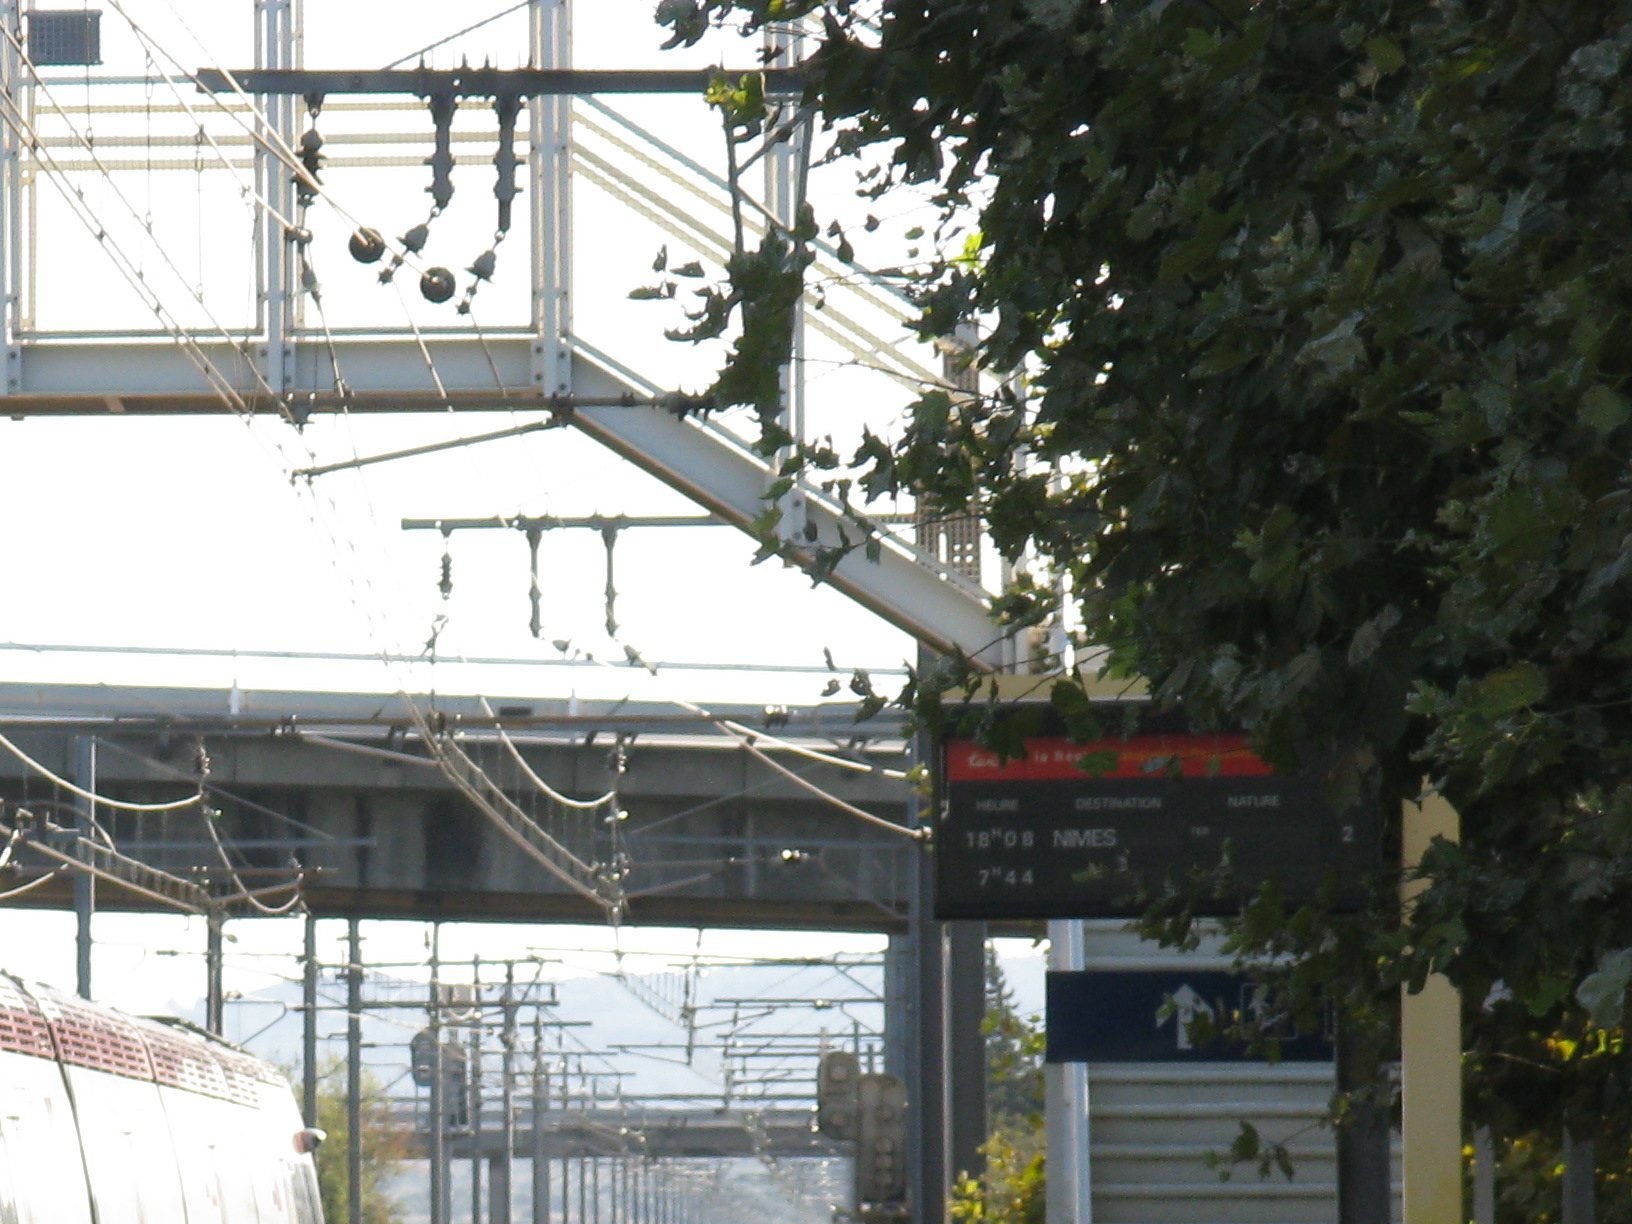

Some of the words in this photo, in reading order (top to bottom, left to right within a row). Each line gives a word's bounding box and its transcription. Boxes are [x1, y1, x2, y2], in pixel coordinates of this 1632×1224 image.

[1075, 797, 1162, 809] DESTINATION
[1227, 795, 1280, 807] NATURE
[1053, 827, 1118, 847] NIMES
[1341, 825, 1354, 843] 2
